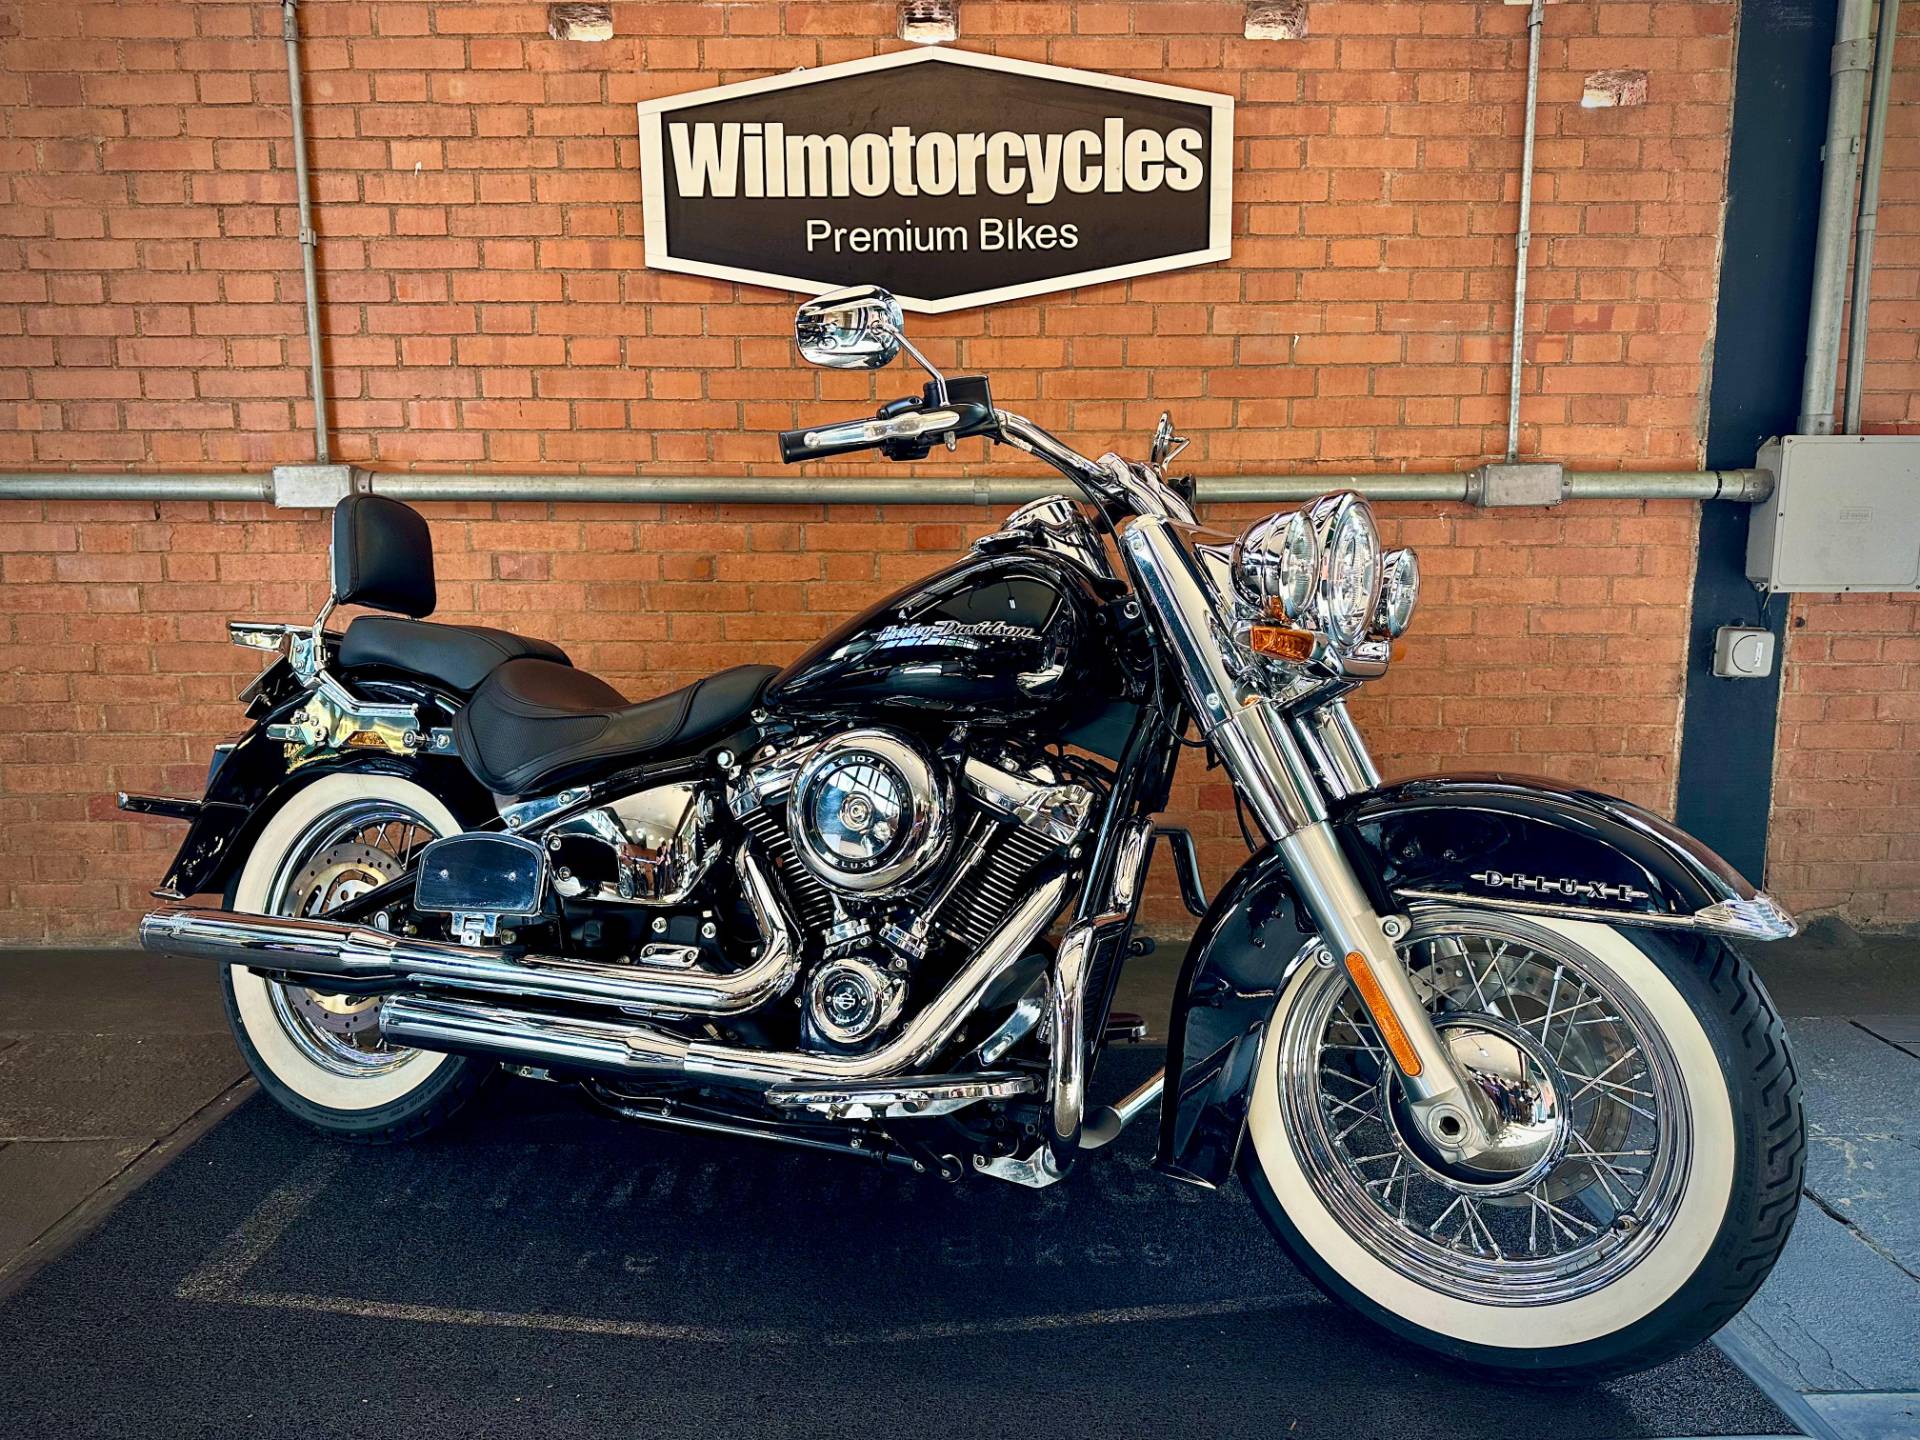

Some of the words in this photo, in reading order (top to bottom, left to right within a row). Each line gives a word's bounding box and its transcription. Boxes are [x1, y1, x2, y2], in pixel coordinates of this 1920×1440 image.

[668, 117, 1204, 205] Wilmotorcycles
[806, 219, 968, 254] Premium
[851, 755, 875, 764] 107
[1484, 870, 1634, 902] DELUXE
